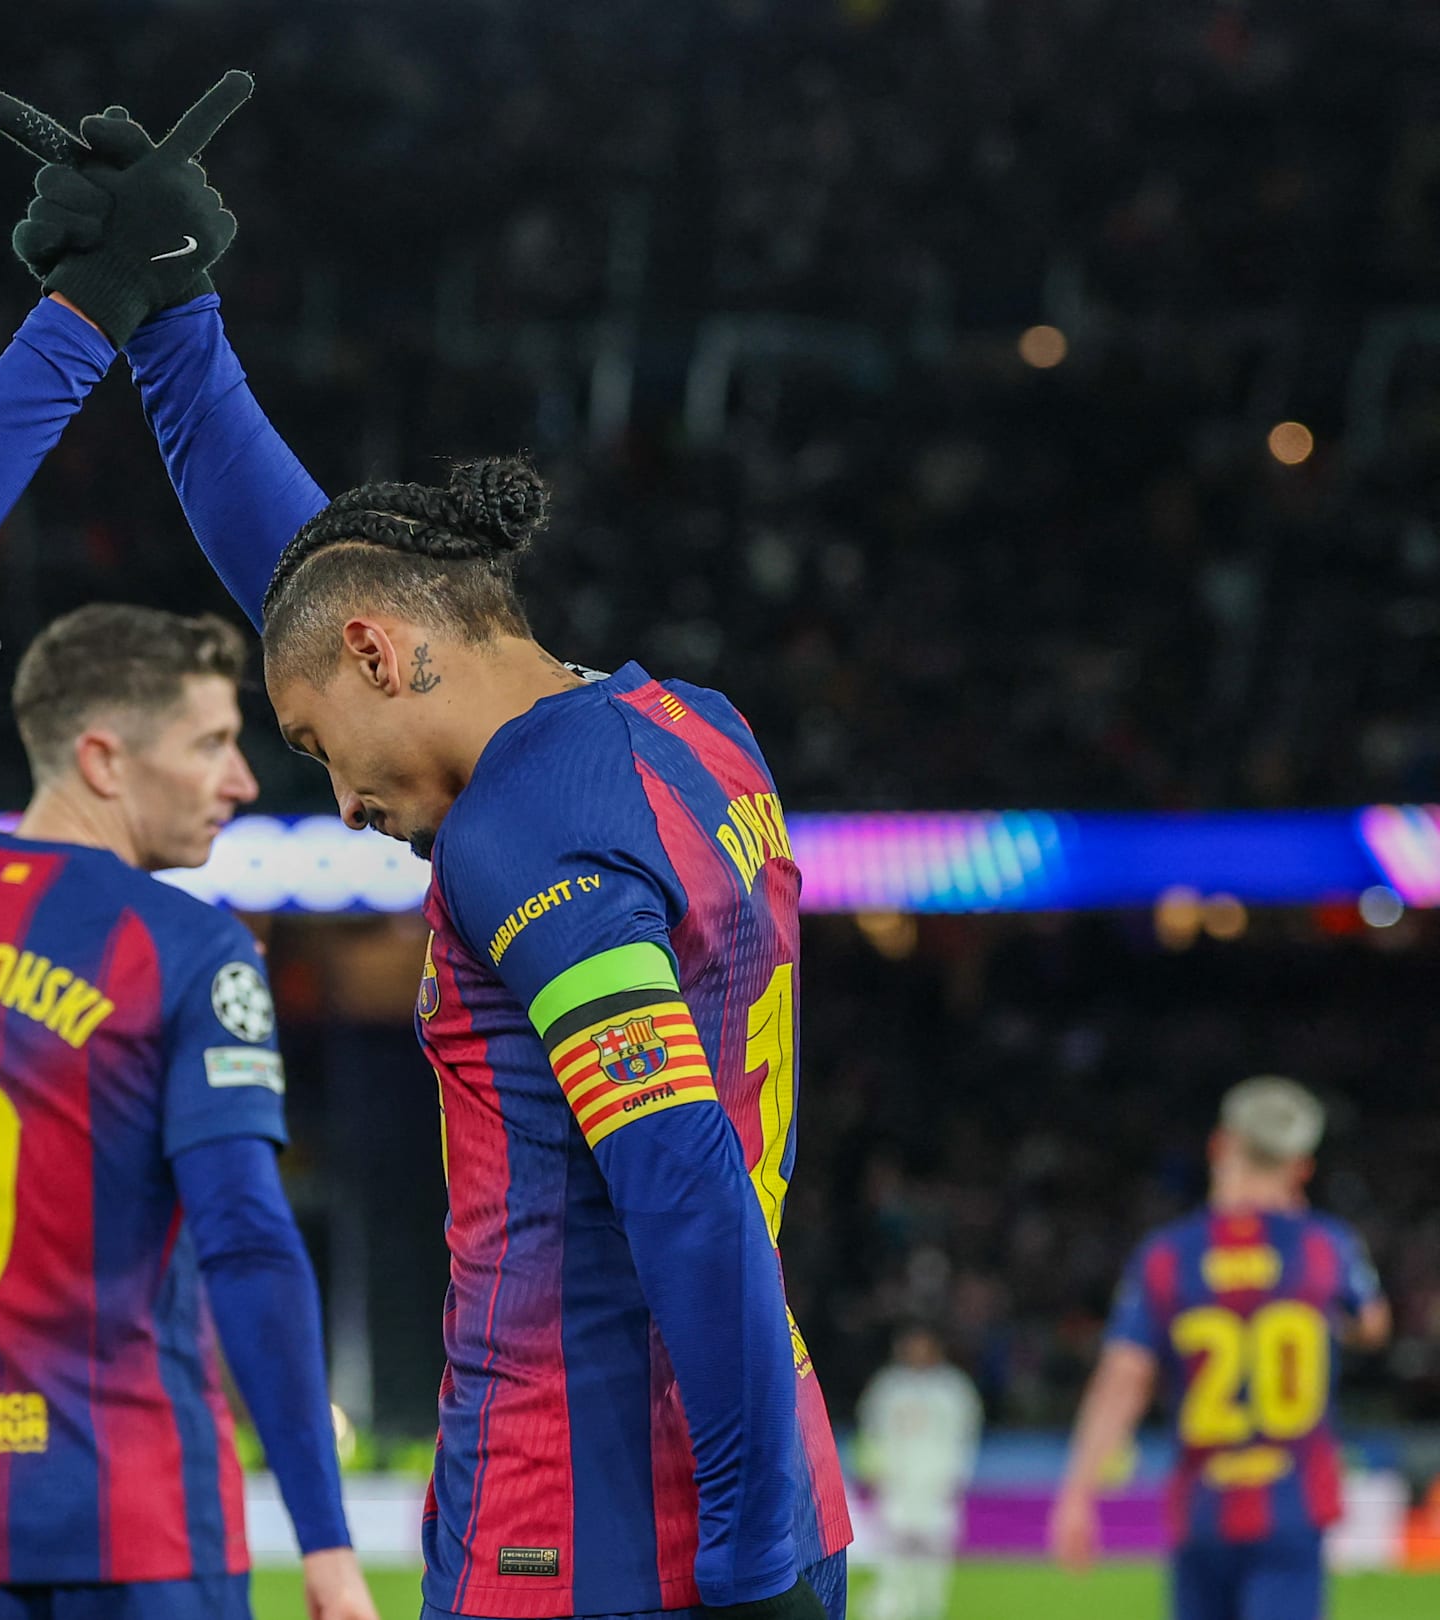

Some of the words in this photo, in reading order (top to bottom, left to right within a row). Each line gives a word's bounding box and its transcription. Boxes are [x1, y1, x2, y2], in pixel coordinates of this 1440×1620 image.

[488, 880, 572, 967] AMBILIGHT
[576, 874, 600, 892] tv
[623, 1083, 676, 1112] CAPITÀ
[1171, 1302, 1330, 1446] 20
